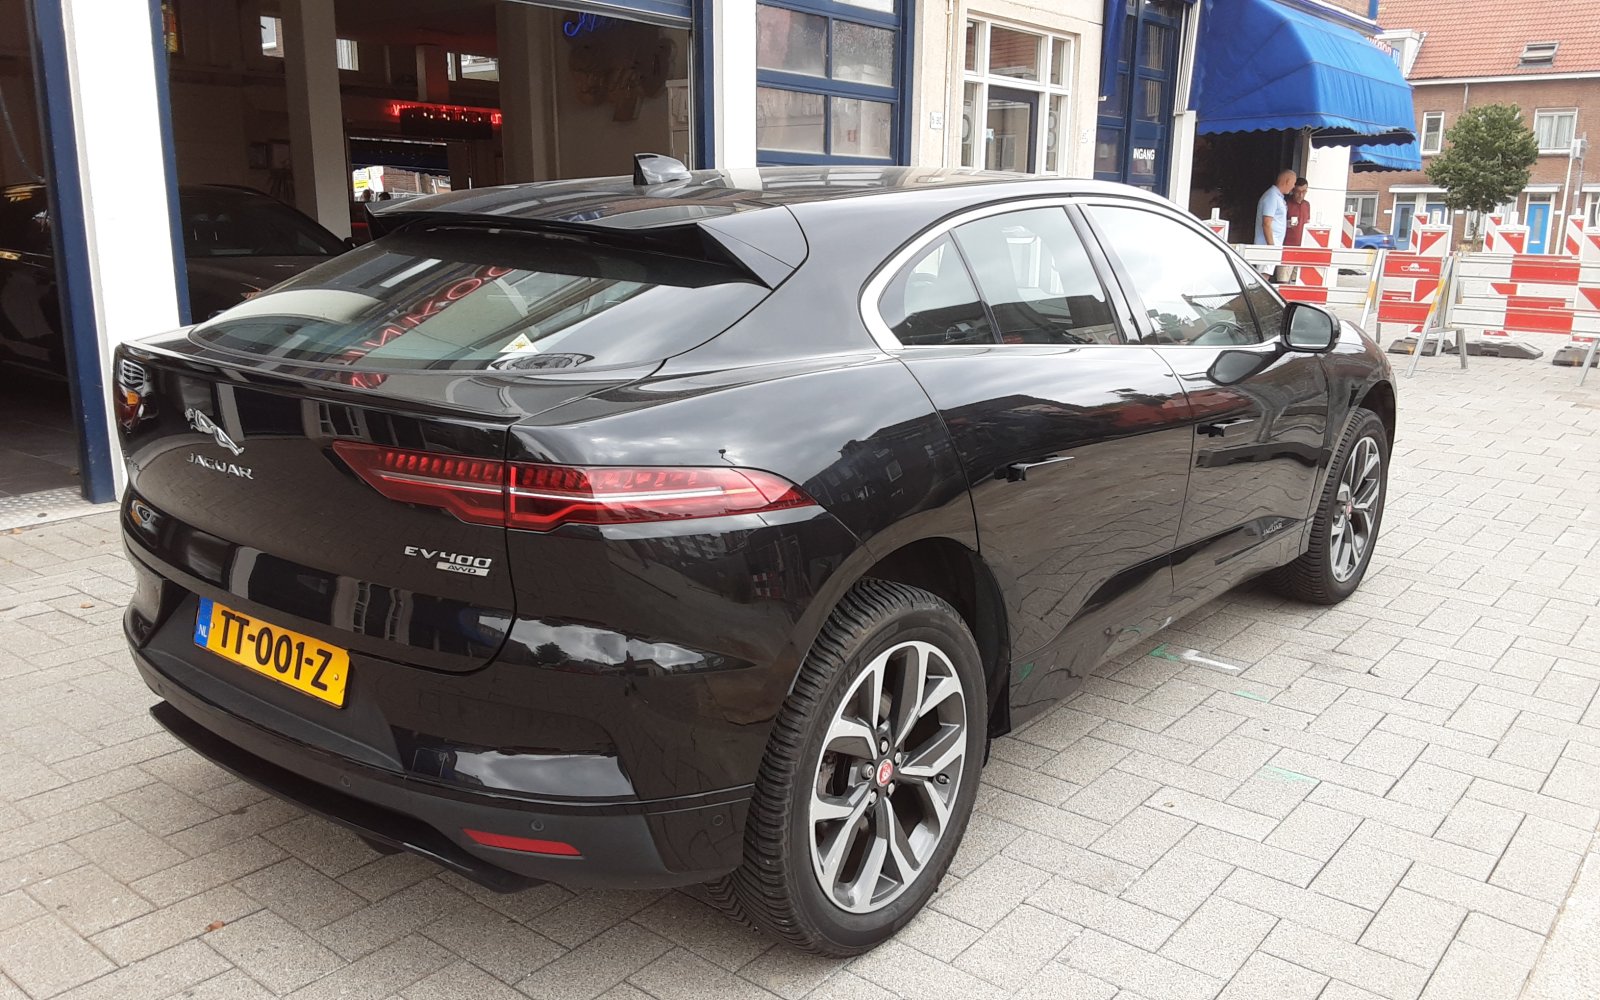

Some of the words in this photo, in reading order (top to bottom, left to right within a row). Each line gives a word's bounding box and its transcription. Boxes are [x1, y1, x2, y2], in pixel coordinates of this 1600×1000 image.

[1133, 147, 1156, 160] INGANG
[186, 452, 254, 480] JAGUAR
[404, 545, 492, 568] EV400
[447, 564, 477, 574] AWD
[198, 623, 208, 638] NL
[220, 609, 333, 692] TT-001-Z
